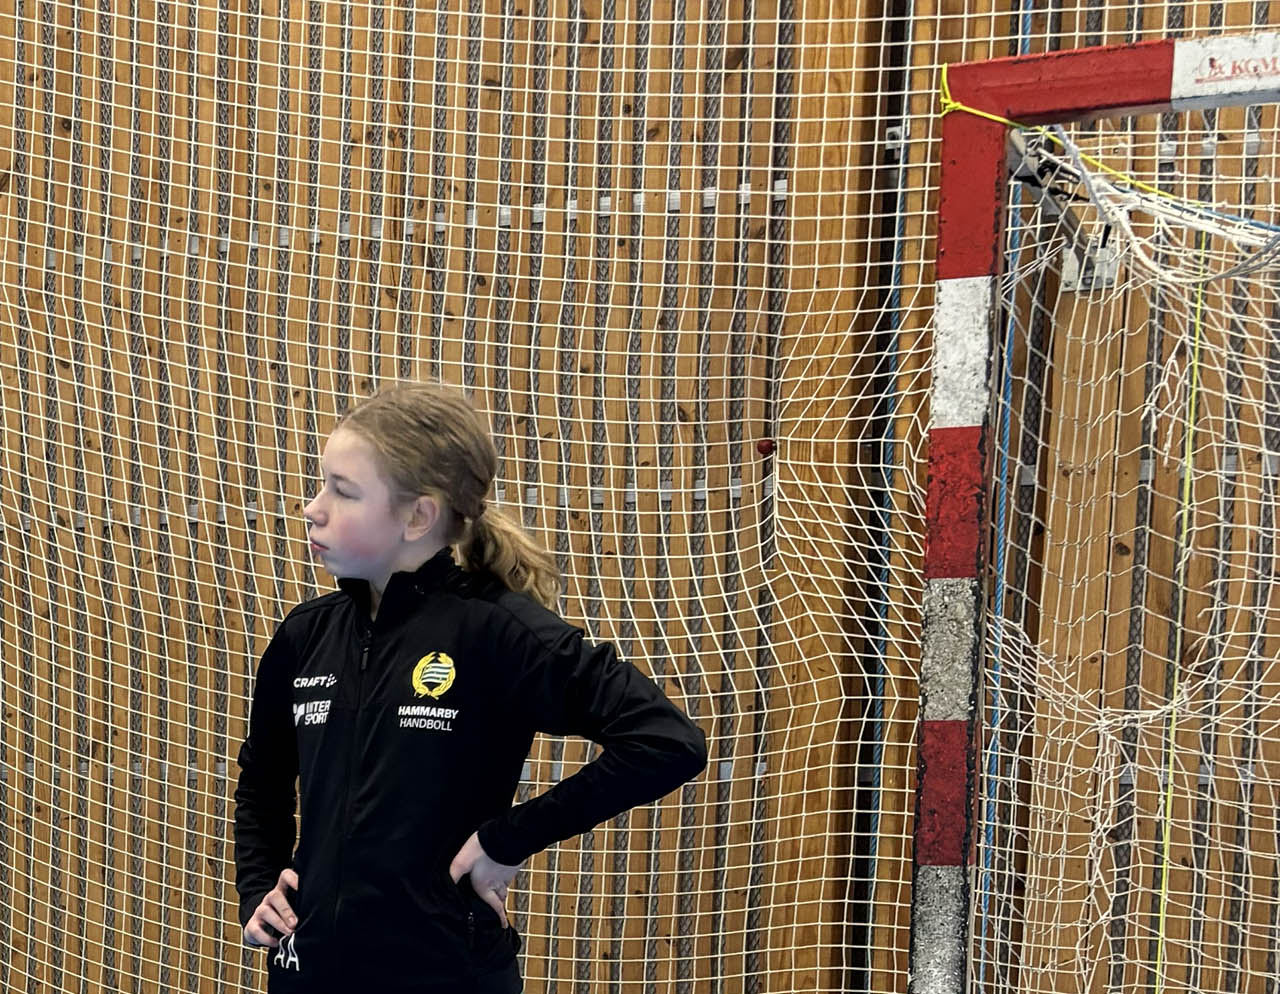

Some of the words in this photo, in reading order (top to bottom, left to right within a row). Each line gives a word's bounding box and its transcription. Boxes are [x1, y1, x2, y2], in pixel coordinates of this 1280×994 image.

[293, 675, 327, 688] CRAFT
[305, 700, 331, 713] INTER
[398, 705, 459, 719] HAMMARBY
[305, 711, 328, 725] SPORT
[399, 718, 453, 731] HANDBOLL
[273, 932, 300, 971] AA
